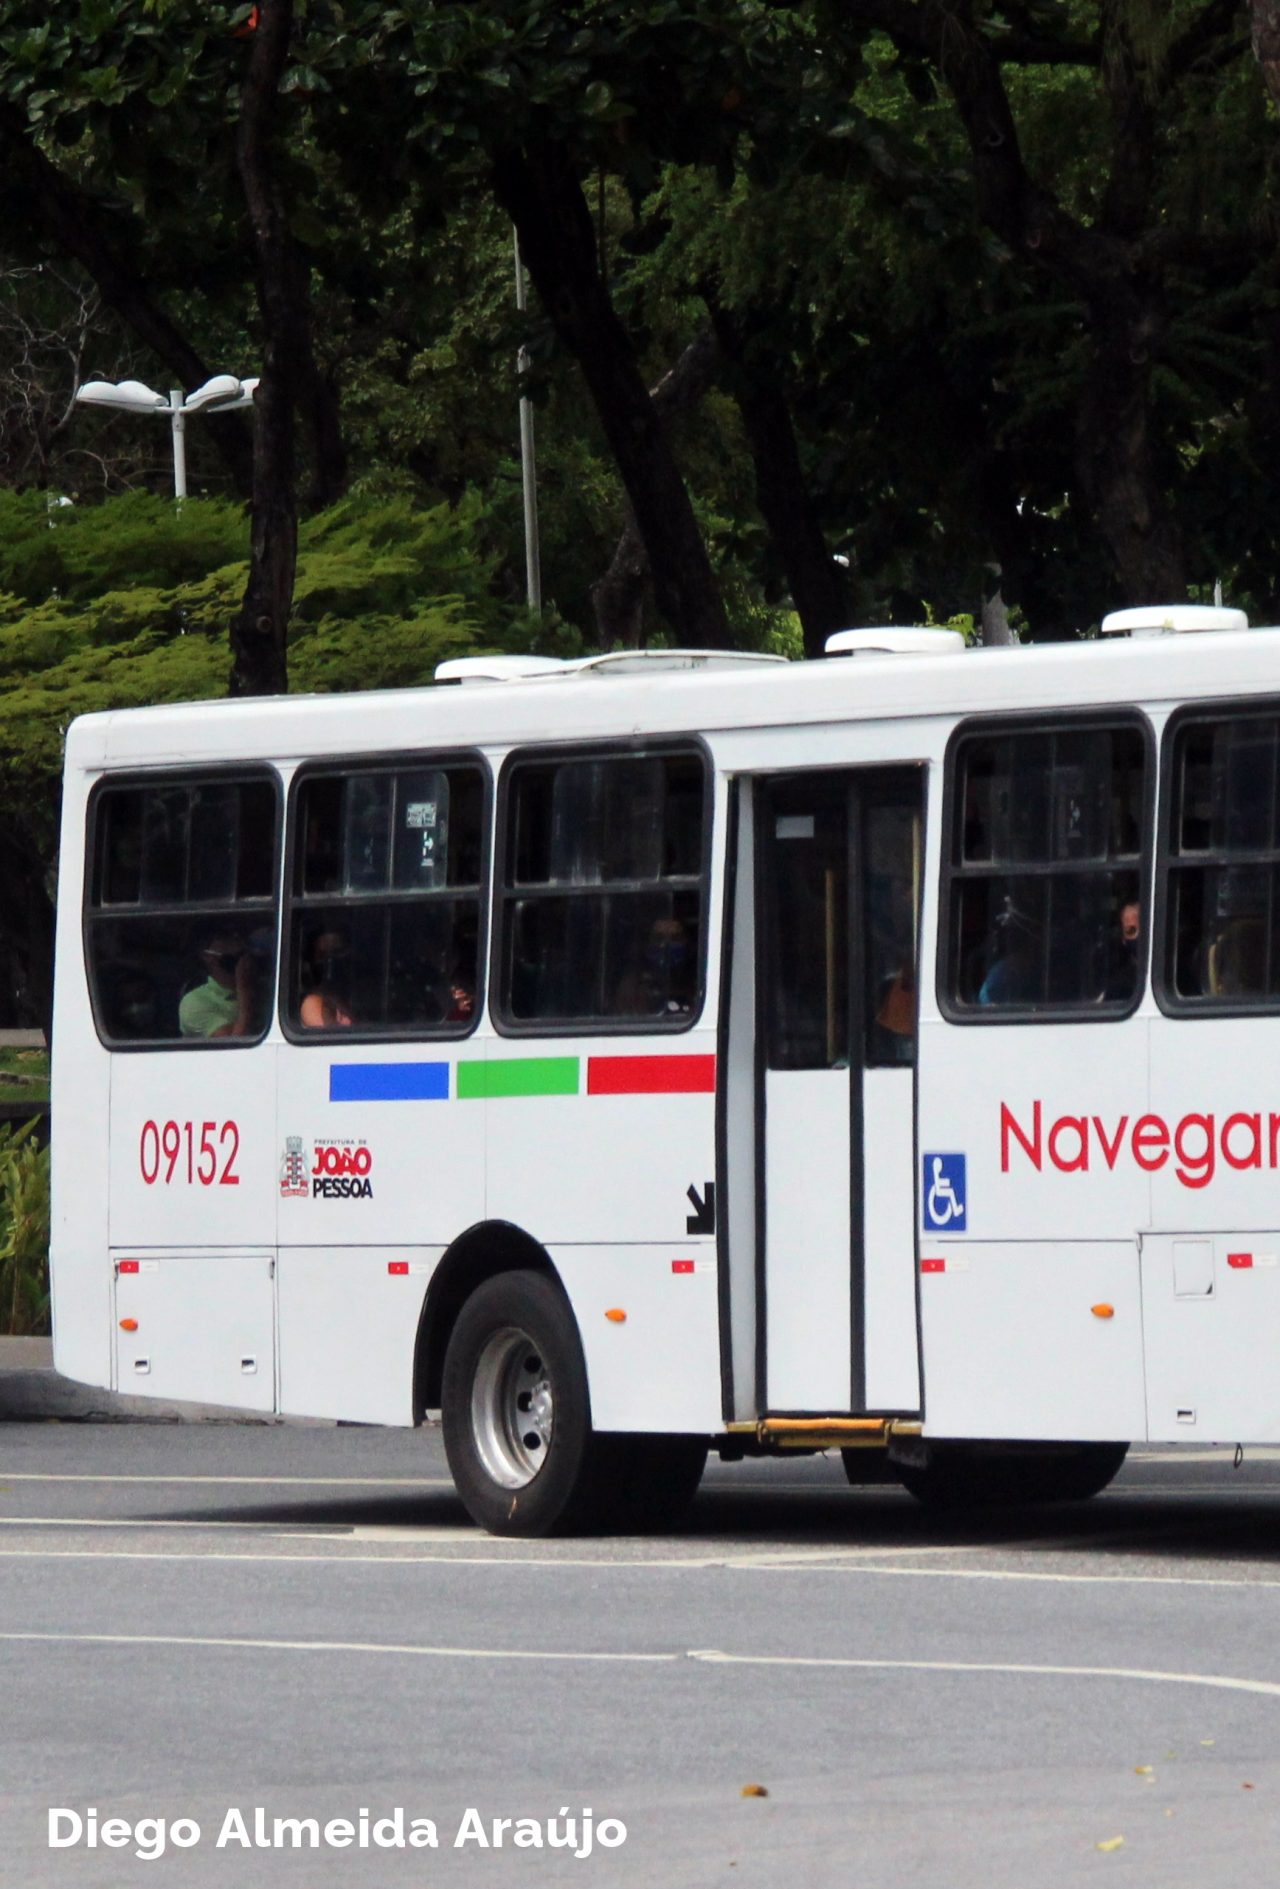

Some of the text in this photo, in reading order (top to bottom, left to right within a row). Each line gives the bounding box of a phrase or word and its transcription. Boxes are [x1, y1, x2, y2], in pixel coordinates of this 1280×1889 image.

[140, 1120, 240, 1185] 09152
[311, 1146, 372, 1176] JOÃO
[313, 1178, 373, 1198] PESSOA
